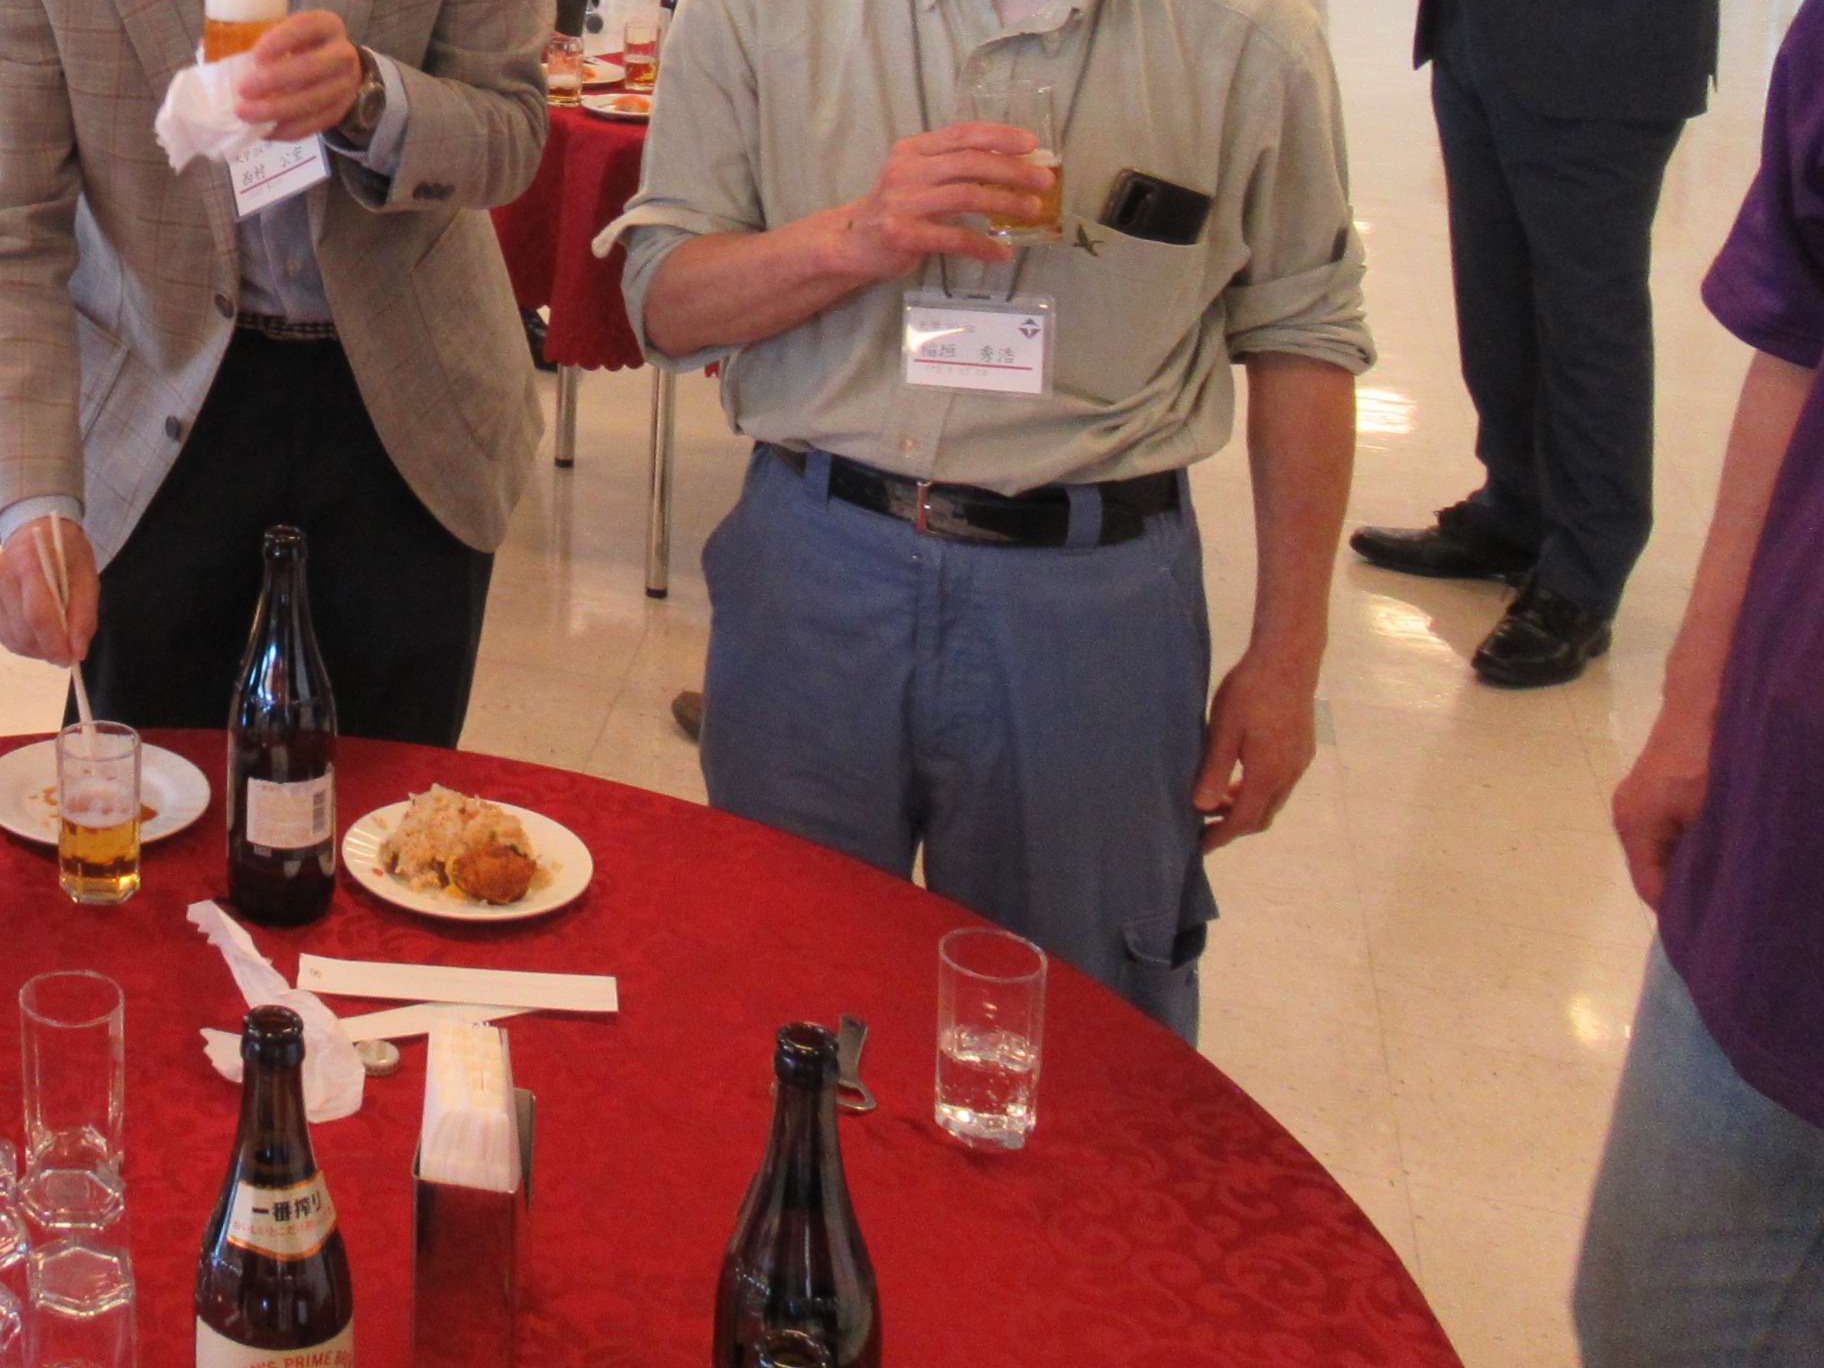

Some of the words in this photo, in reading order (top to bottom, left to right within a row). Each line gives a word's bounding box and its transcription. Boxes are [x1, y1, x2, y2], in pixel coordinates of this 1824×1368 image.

[251, 1190, 322, 1222] 一番搾り
[284, 1350, 333, 1368] PRIME
